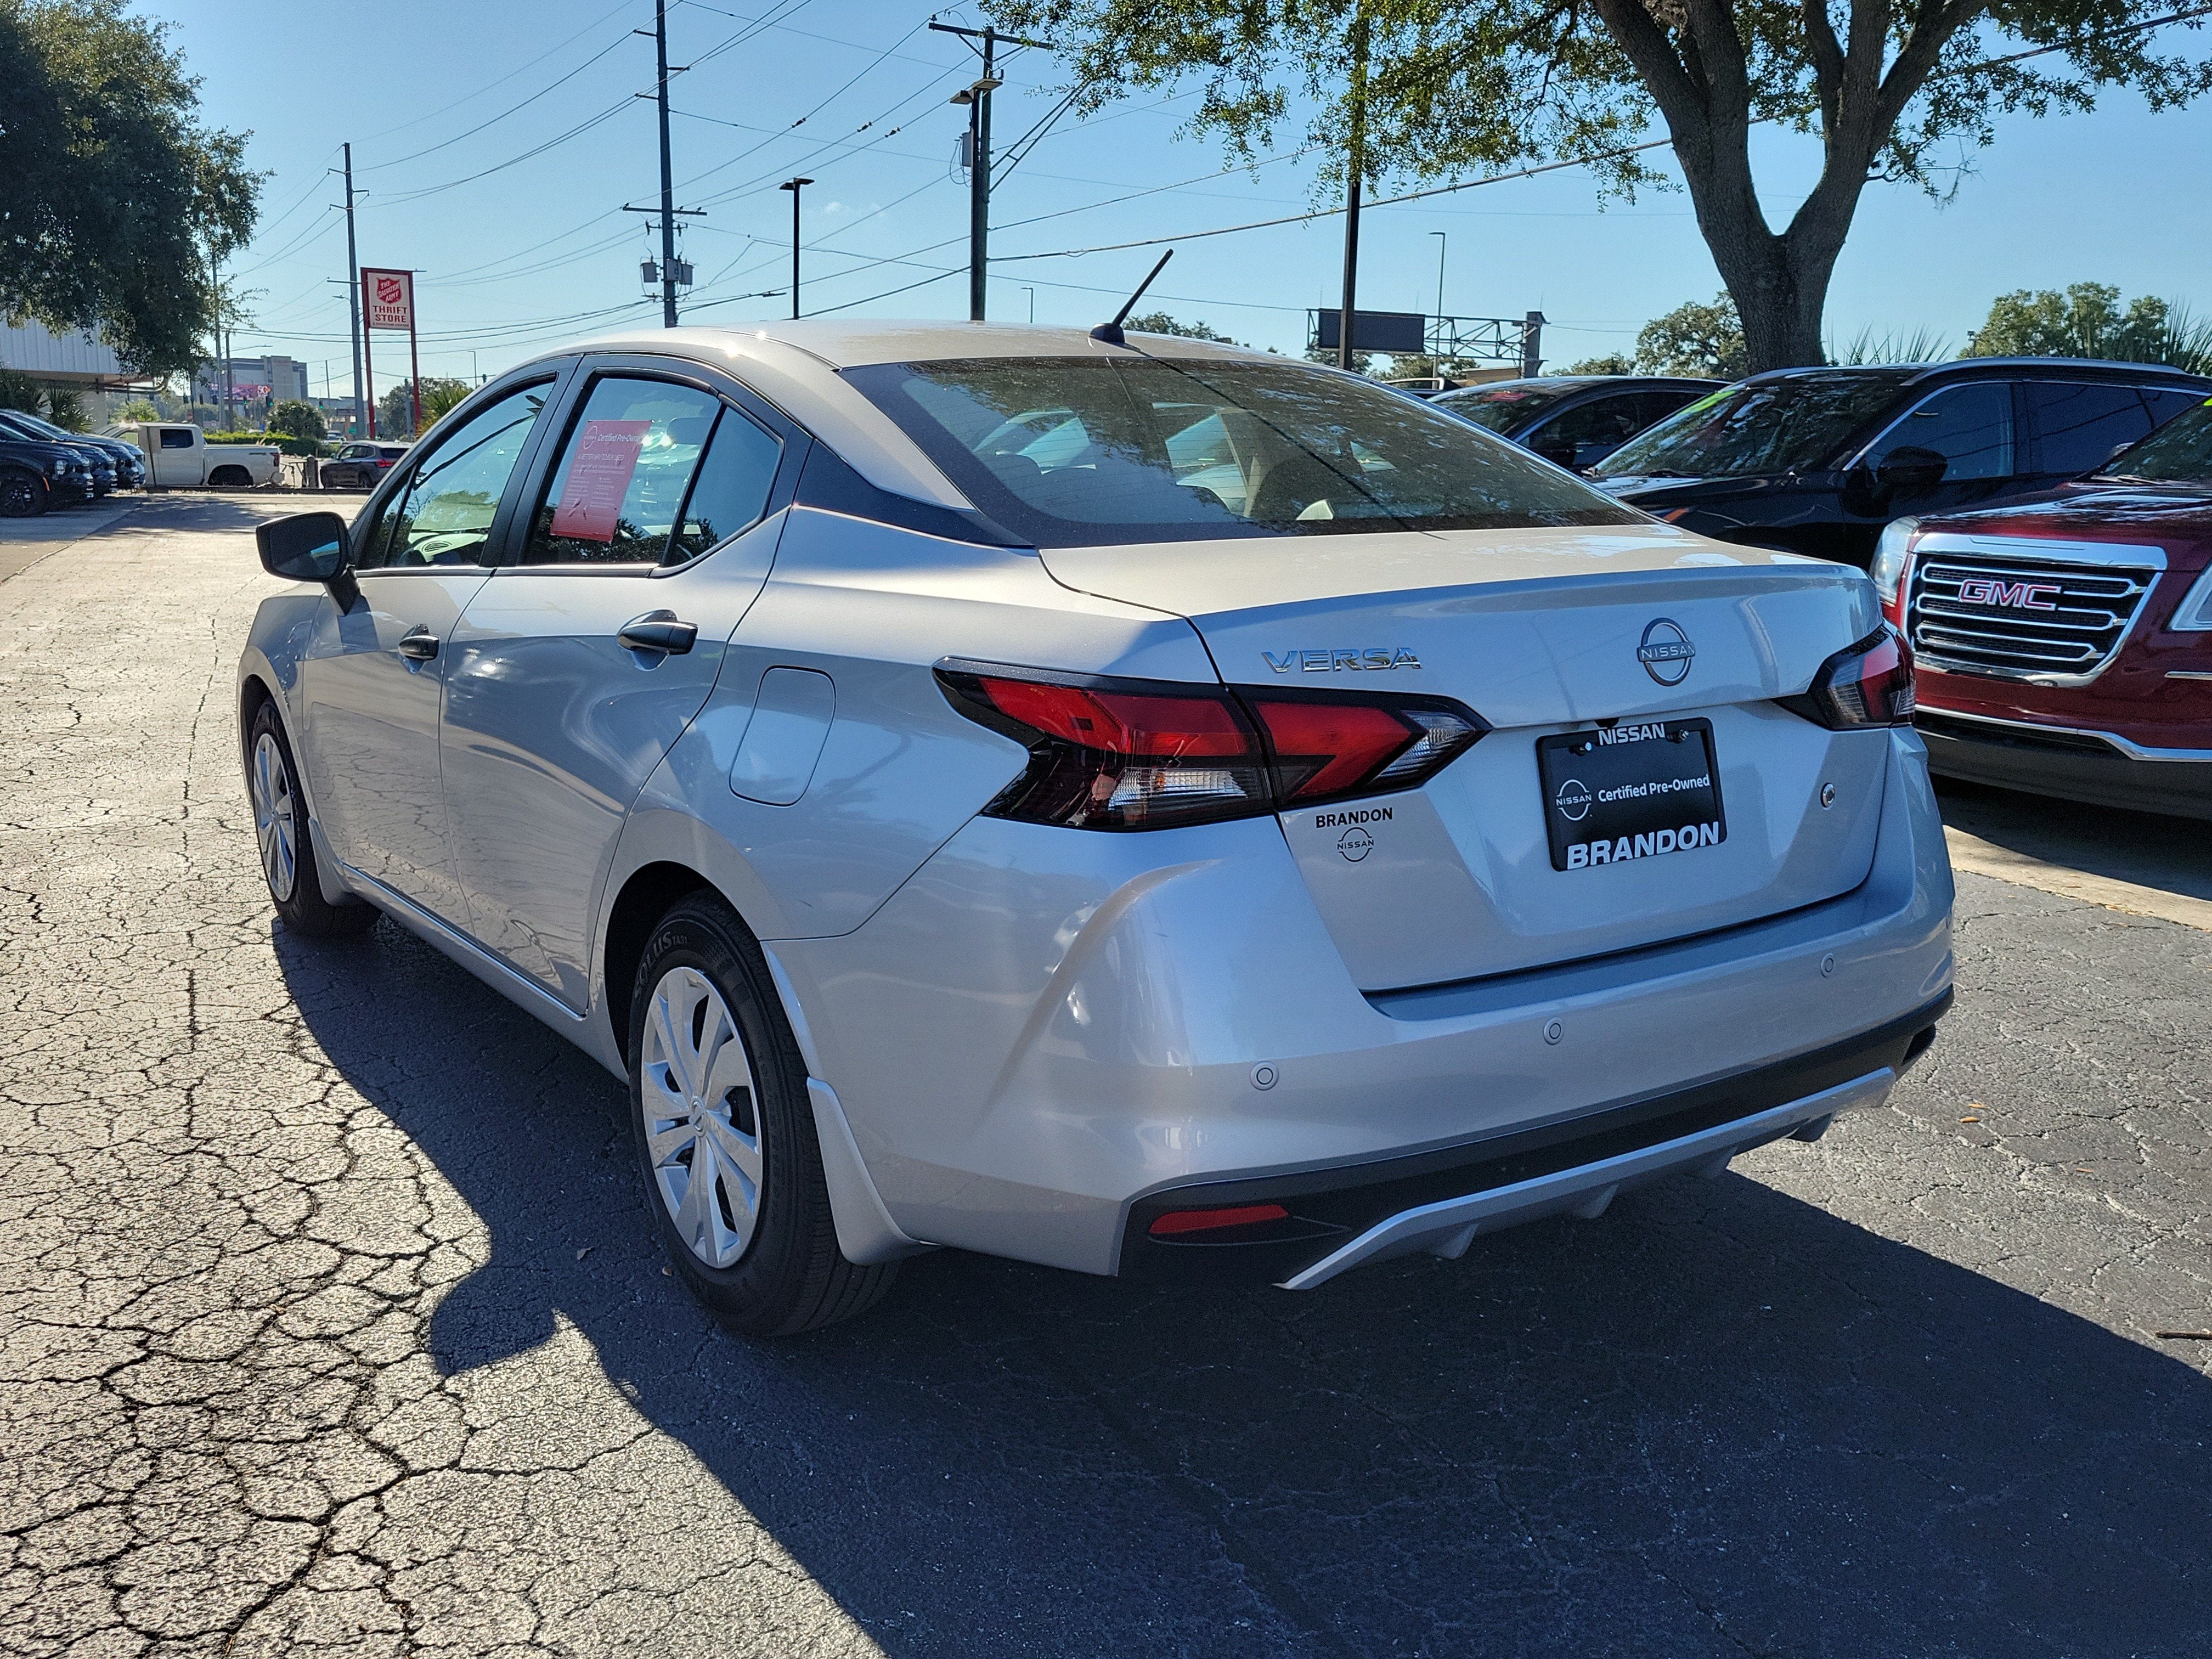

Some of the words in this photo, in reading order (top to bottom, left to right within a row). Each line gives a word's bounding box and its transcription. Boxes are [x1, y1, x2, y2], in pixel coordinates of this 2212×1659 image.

[378, 283, 399, 298] SALVATION
[380, 280, 391, 290] THE
[385, 290, 399, 302] ARMY
[373, 306, 408, 314] THRIFT
[375, 314, 407, 323] STORE
[1959, 579, 2061, 611] GMC
[1641, 645, 1695, 659] NISSAN
[1261, 647, 1423, 674] VERSA
[1598, 723, 1666, 746] NISSAN
[1598, 783, 1647, 802] Certified
[1649, 774, 1711, 795] Pre-Owned
[1556, 794, 1592, 806] NISSAN
[1316, 807, 1393, 828] BRANDON
[1337, 839, 1374, 850] NISSAN
[1567, 821, 1719, 870] BRANDON
